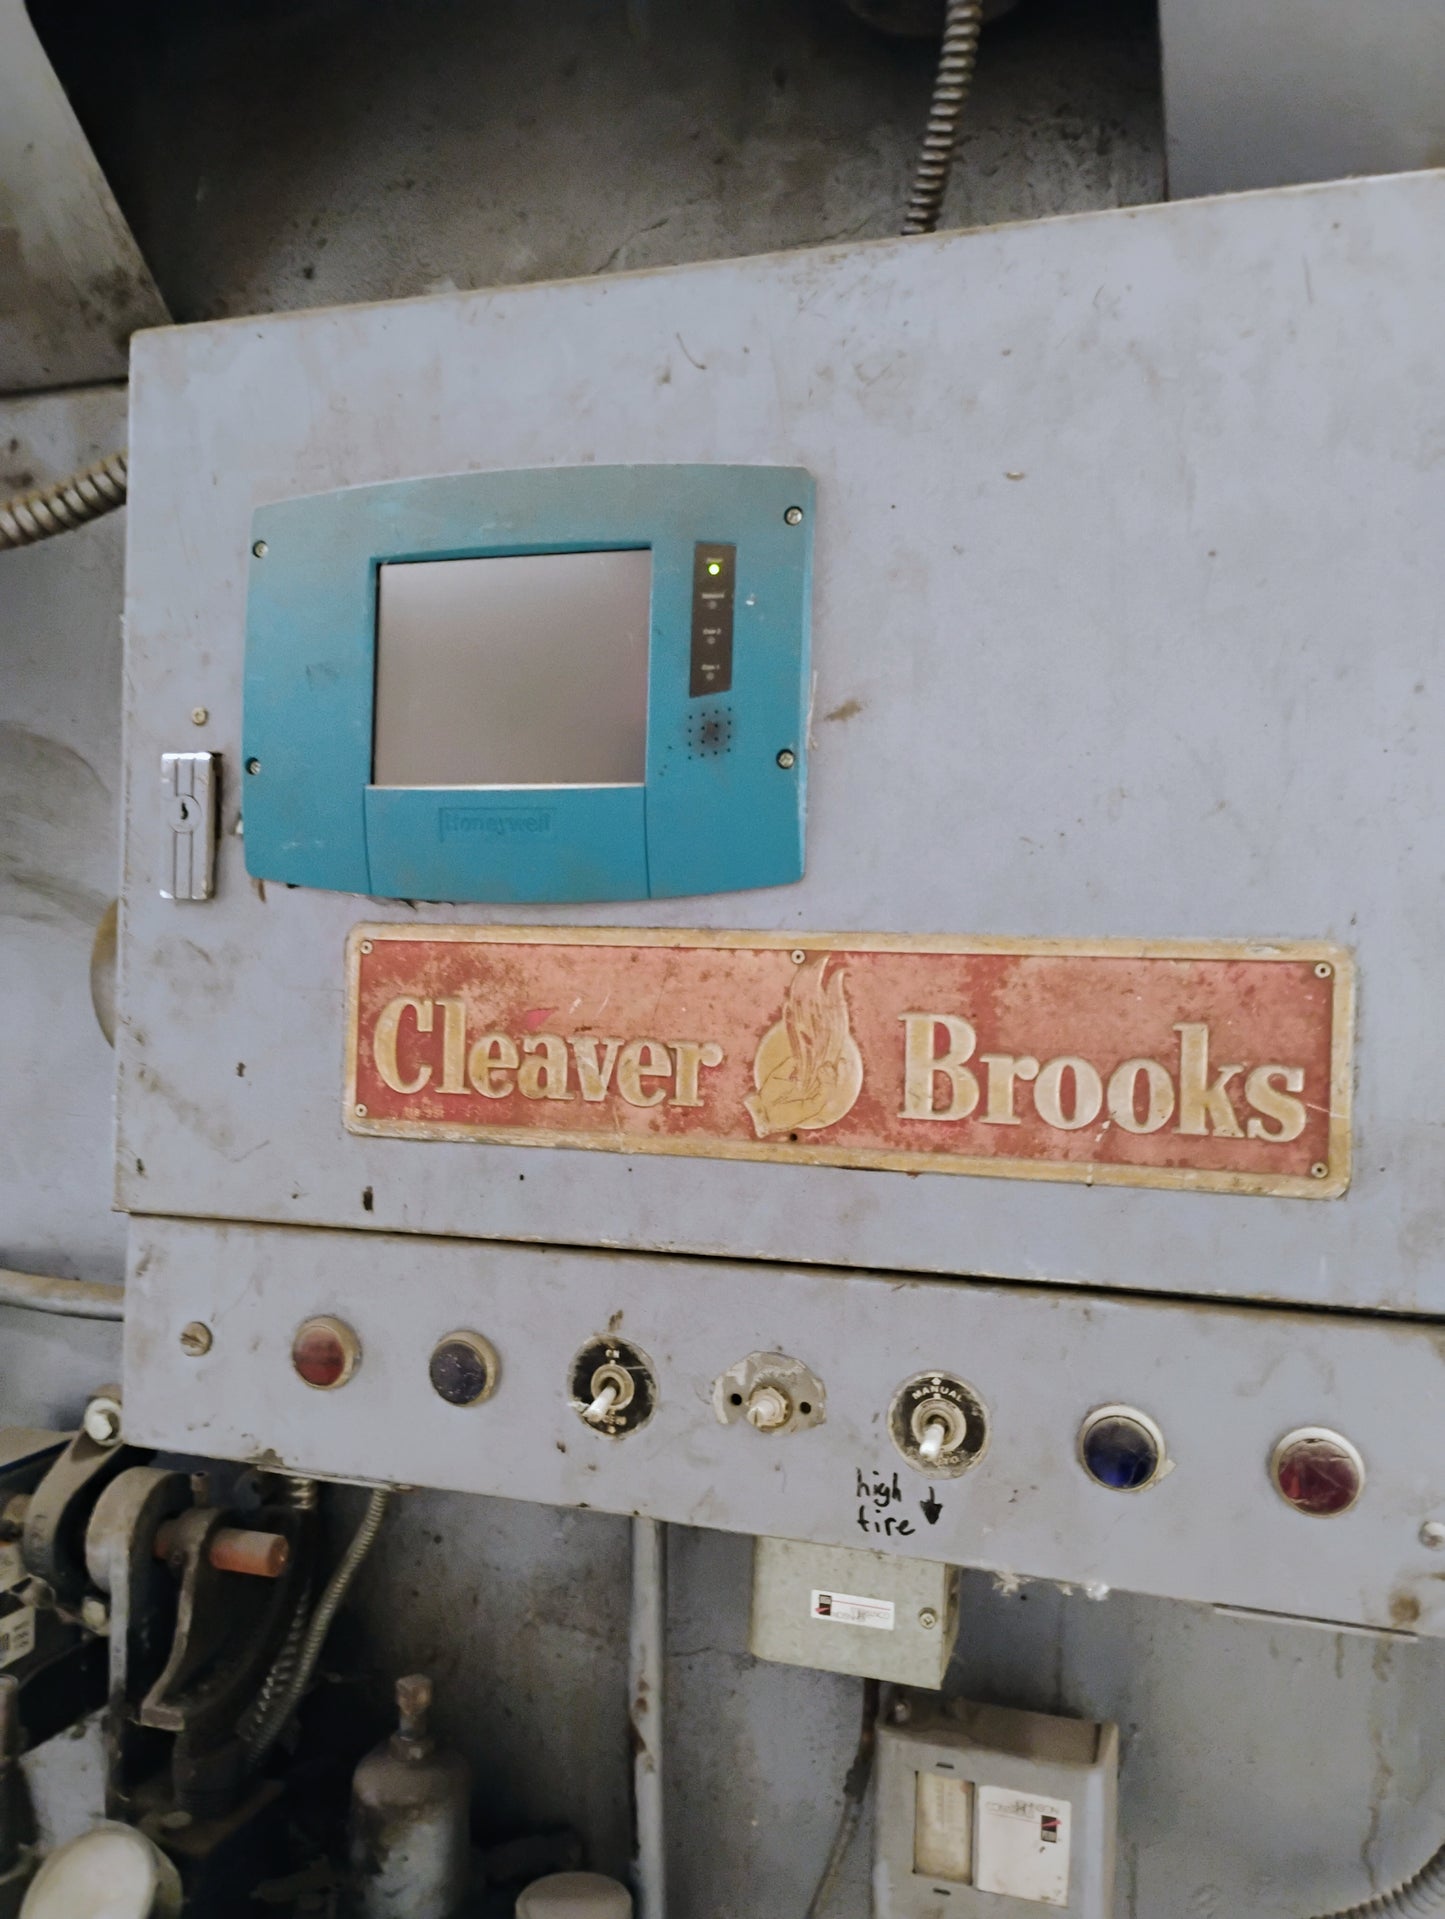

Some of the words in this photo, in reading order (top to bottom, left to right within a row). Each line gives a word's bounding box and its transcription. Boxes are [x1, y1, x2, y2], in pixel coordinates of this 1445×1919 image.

[445, 811, 551, 836] Honeywell
[373, 994, 724, 1107] Cleaver
[897, 1011, 1307, 1143] Brooks
[911, 1384, 963, 1402] MANUAL
[856, 1466, 903, 1508] high
